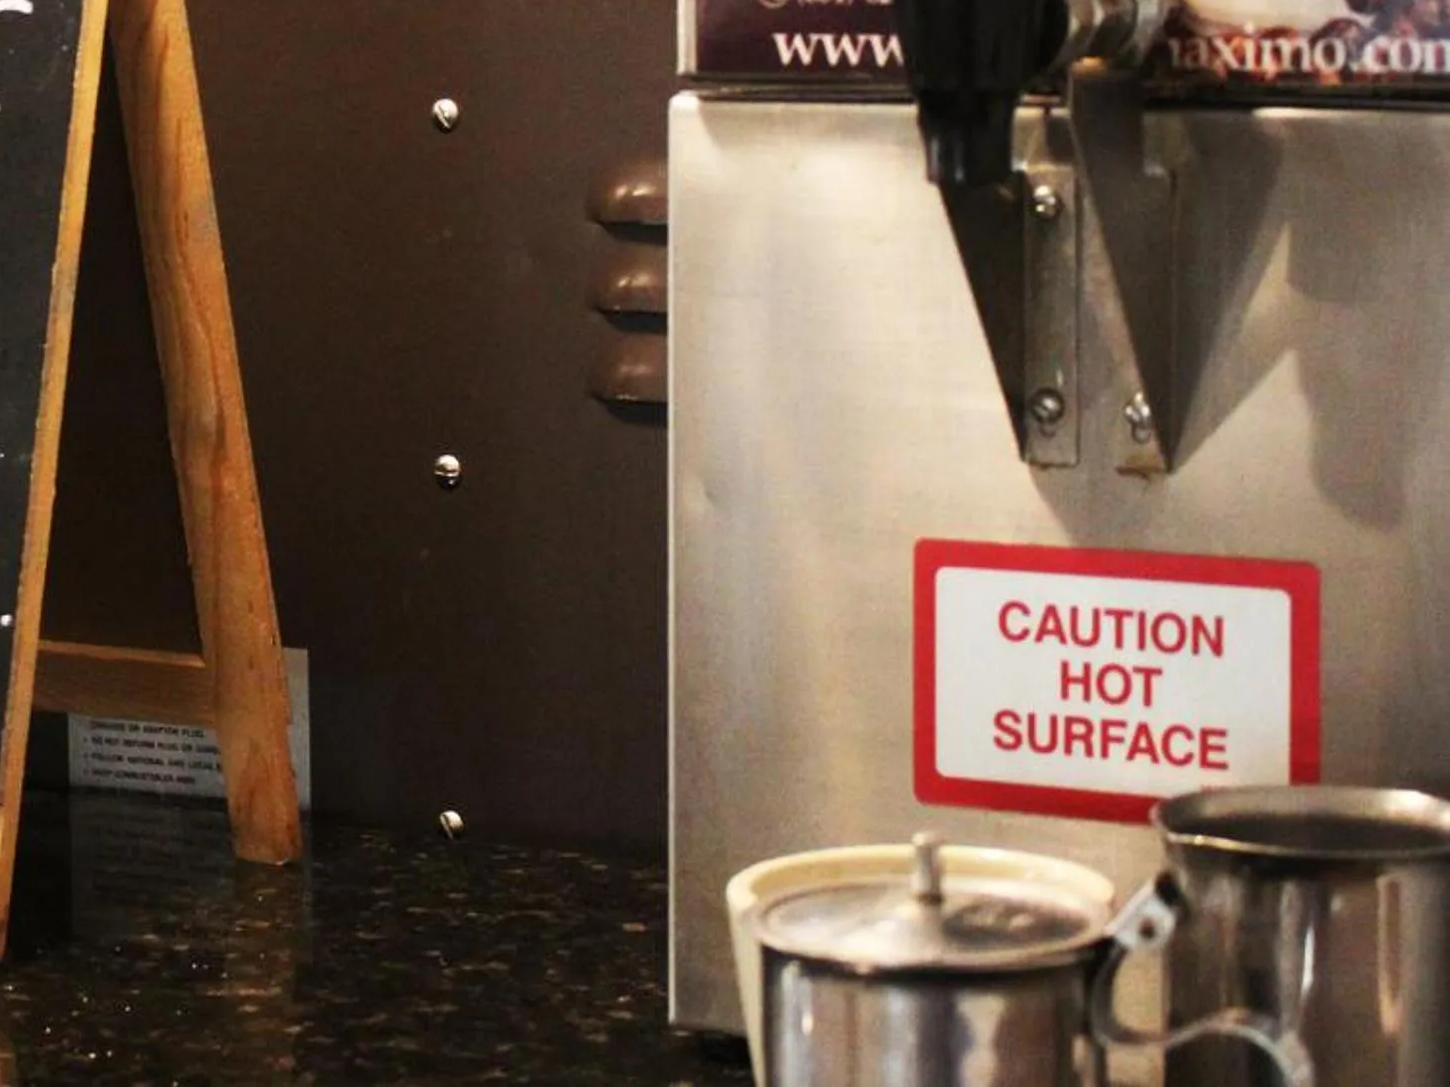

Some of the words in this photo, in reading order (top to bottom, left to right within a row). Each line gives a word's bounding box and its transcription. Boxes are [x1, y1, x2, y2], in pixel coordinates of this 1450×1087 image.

[771, 33, 905, 68] www
[998, 600, 1225, 657] CAUTION
[1060, 660, 1163, 708] HOT
[993, 710, 1229, 771] SURFACE
